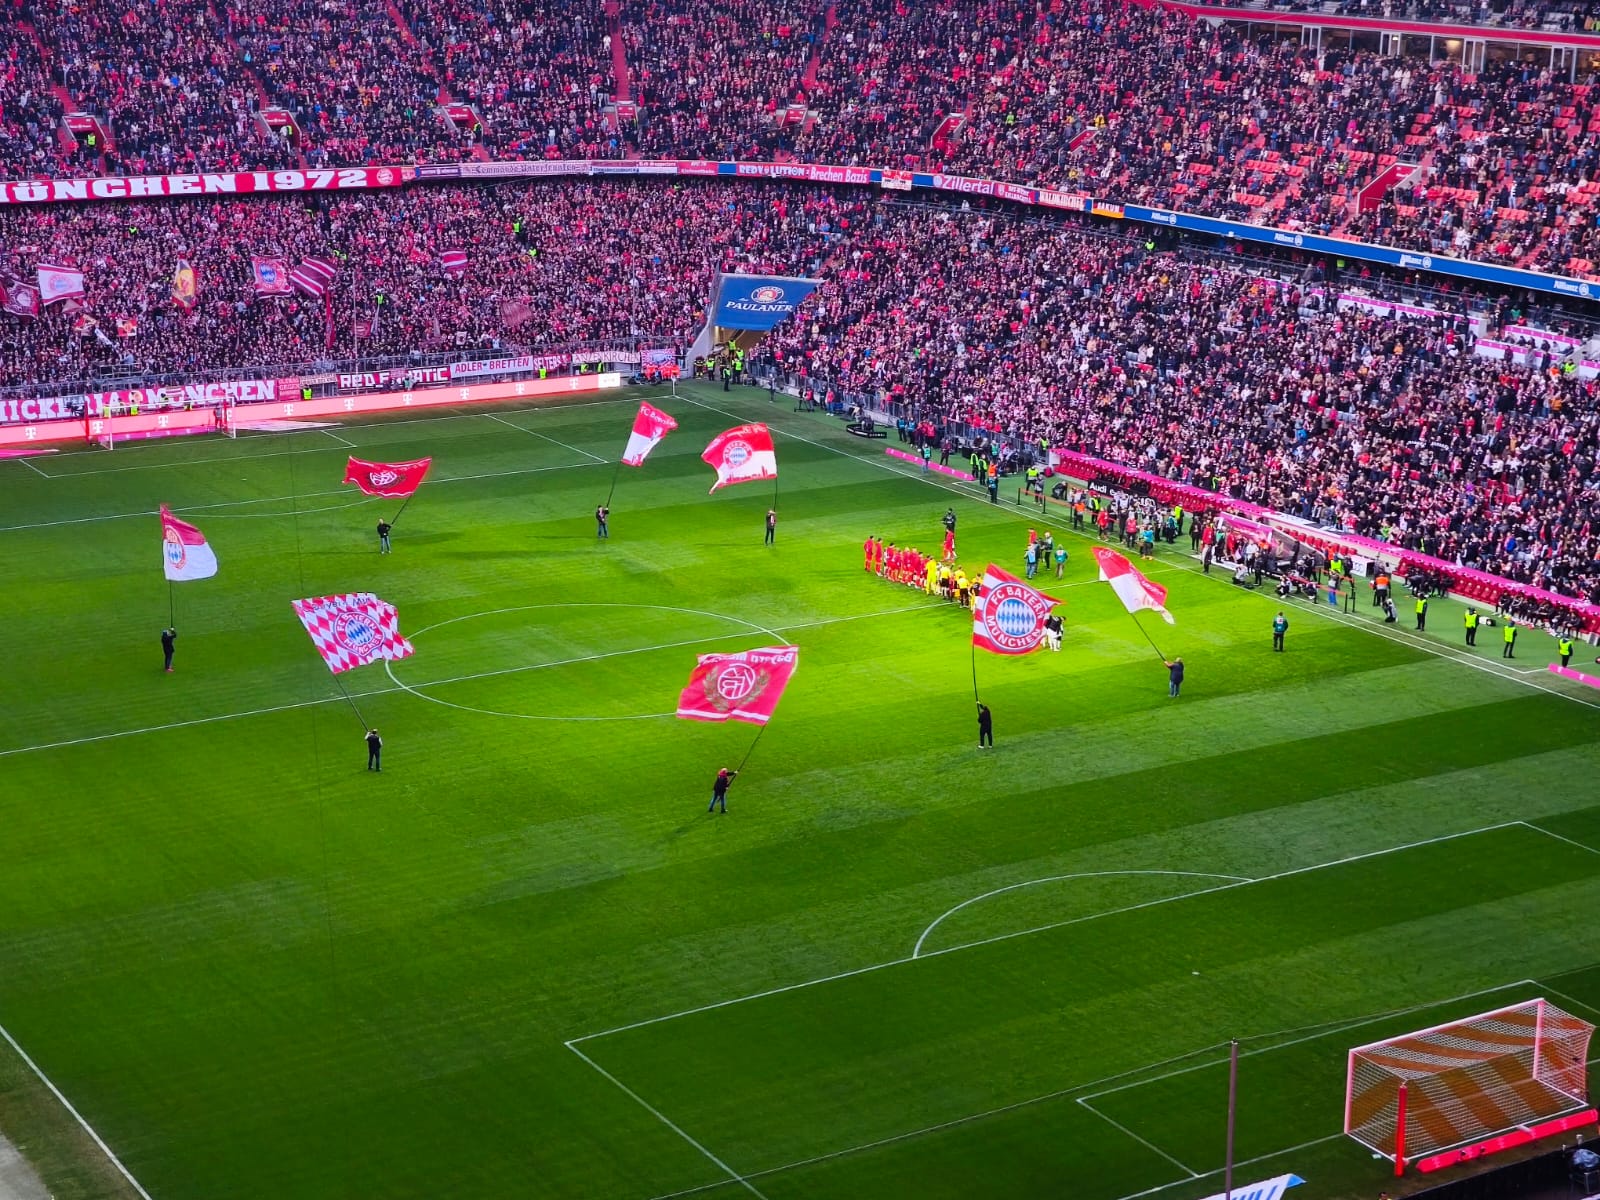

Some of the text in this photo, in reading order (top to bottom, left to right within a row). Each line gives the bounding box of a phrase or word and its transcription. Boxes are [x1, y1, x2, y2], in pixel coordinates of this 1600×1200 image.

[810, 167, 843, 182] Brechen
[846, 169, 868, 184] Bazis
[0, 173, 236, 203] ÜNCHEN
[253, 169, 367, 191] 1972
[942, 175, 994, 195] Zillertal
[1151, 212, 1169, 222] Allianz
[1274, 232, 1294, 243] Allianz
[1554, 280, 1579, 293] Allianz
[725, 301, 793, 312] PAULANER
[455, 362, 483, 374] ADLER
[489, 357, 530, 370] BRETTEN
[340, 373, 376, 388] RED
[376, 367, 448, 387] FATIC
[1089, 482, 1107, 494] Audi
[990, 586, 1046, 619] FC BAYERN
